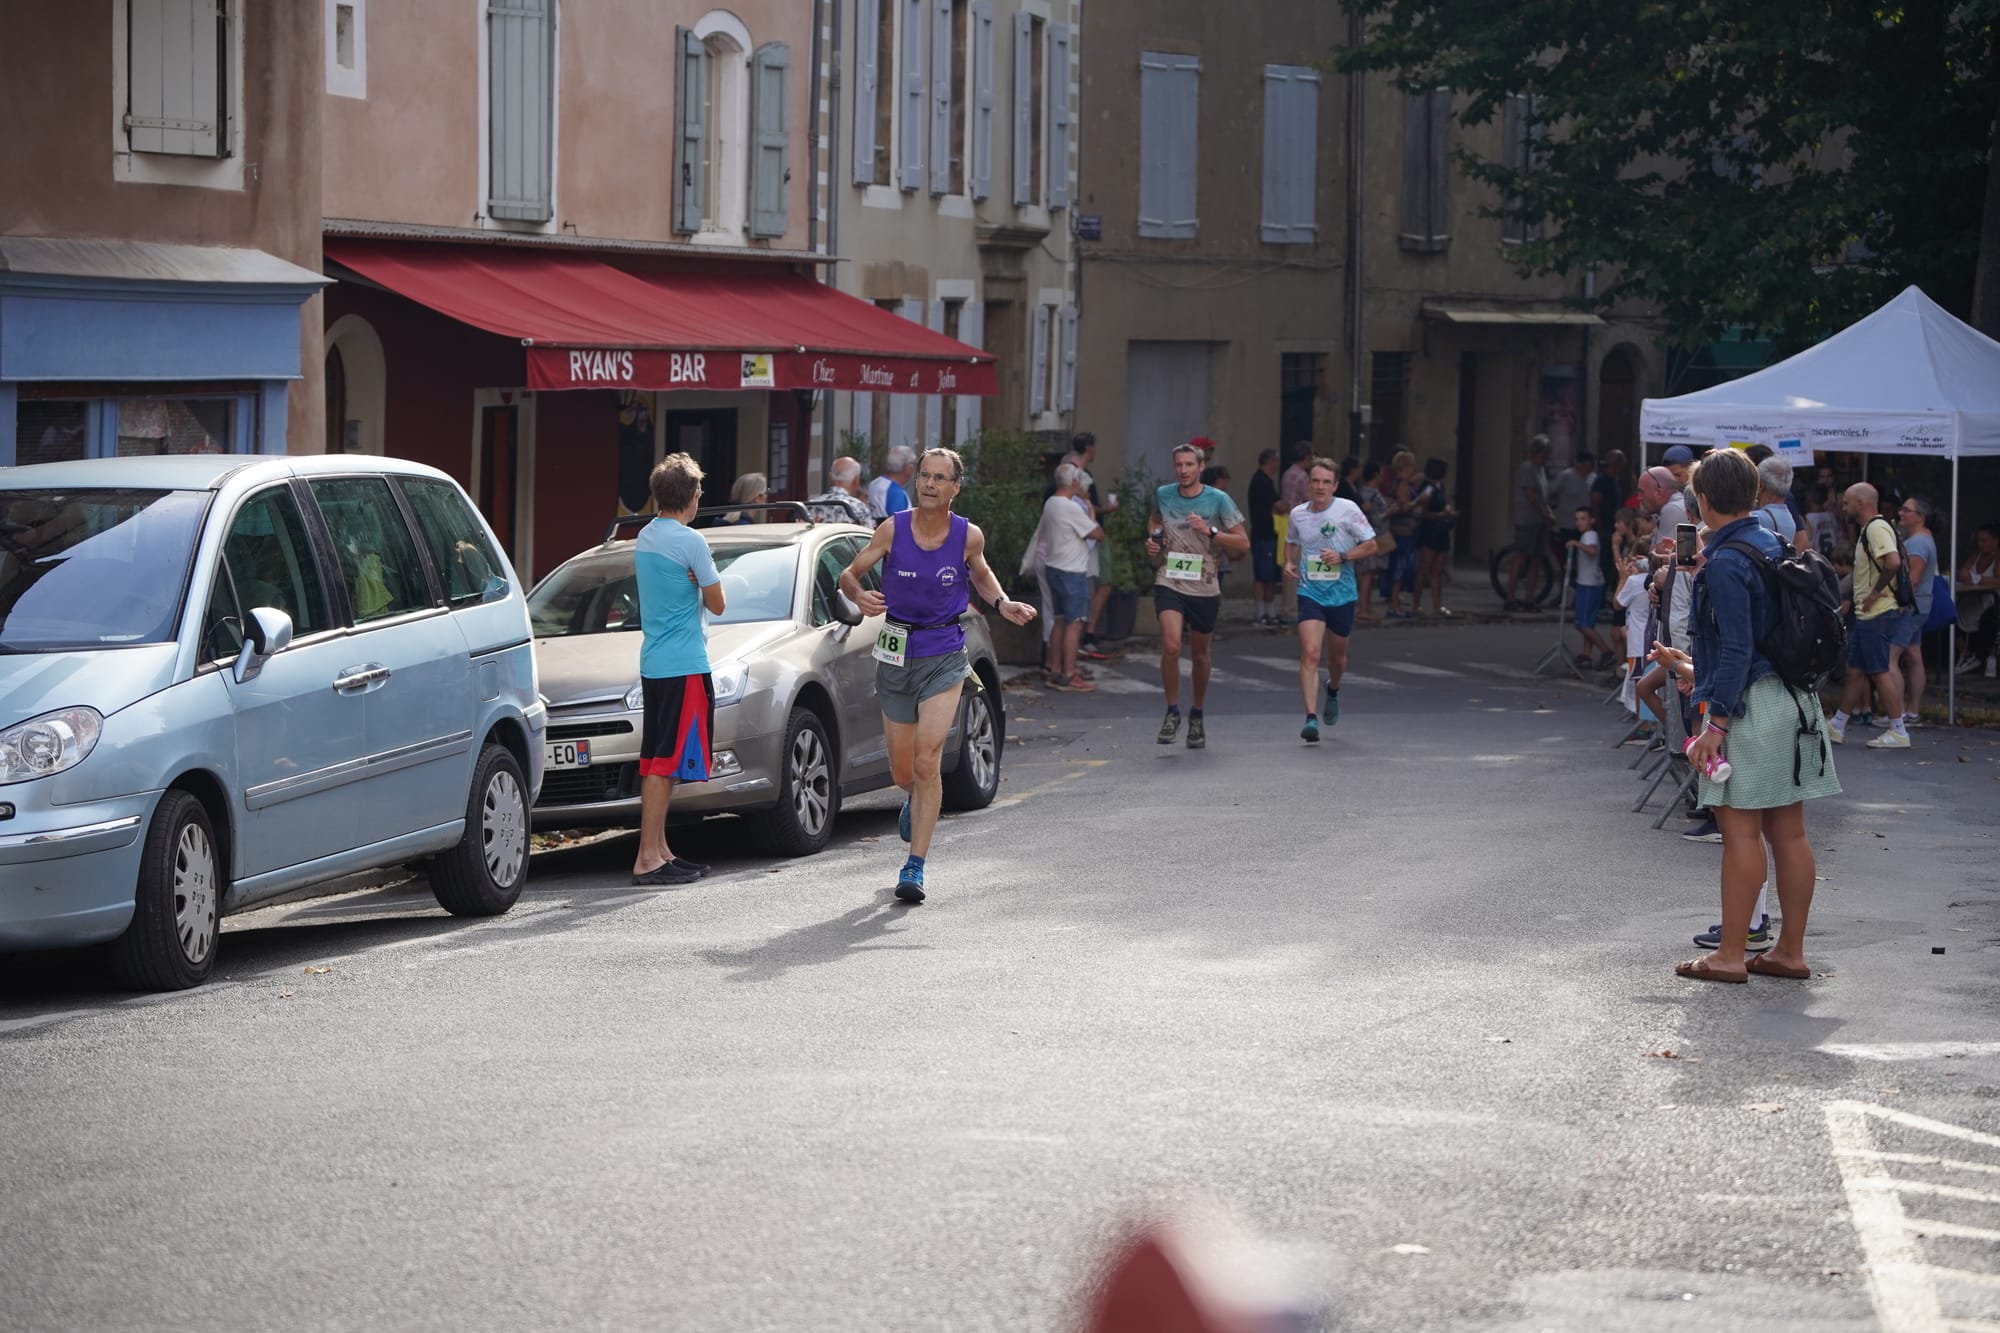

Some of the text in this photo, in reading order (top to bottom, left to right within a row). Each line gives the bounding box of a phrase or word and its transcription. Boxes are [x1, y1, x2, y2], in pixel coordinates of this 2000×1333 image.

[569, 351, 705, 382] RYAN'S BAR
[812, 357, 835, 384] Chez
[859, 363, 894, 386] Martine
[910, 370, 919, 387] et
[1175, 560, 1192, 571] 47
[1315, 561, 1331, 572] 73
[578, 753, 588, 764] 48
